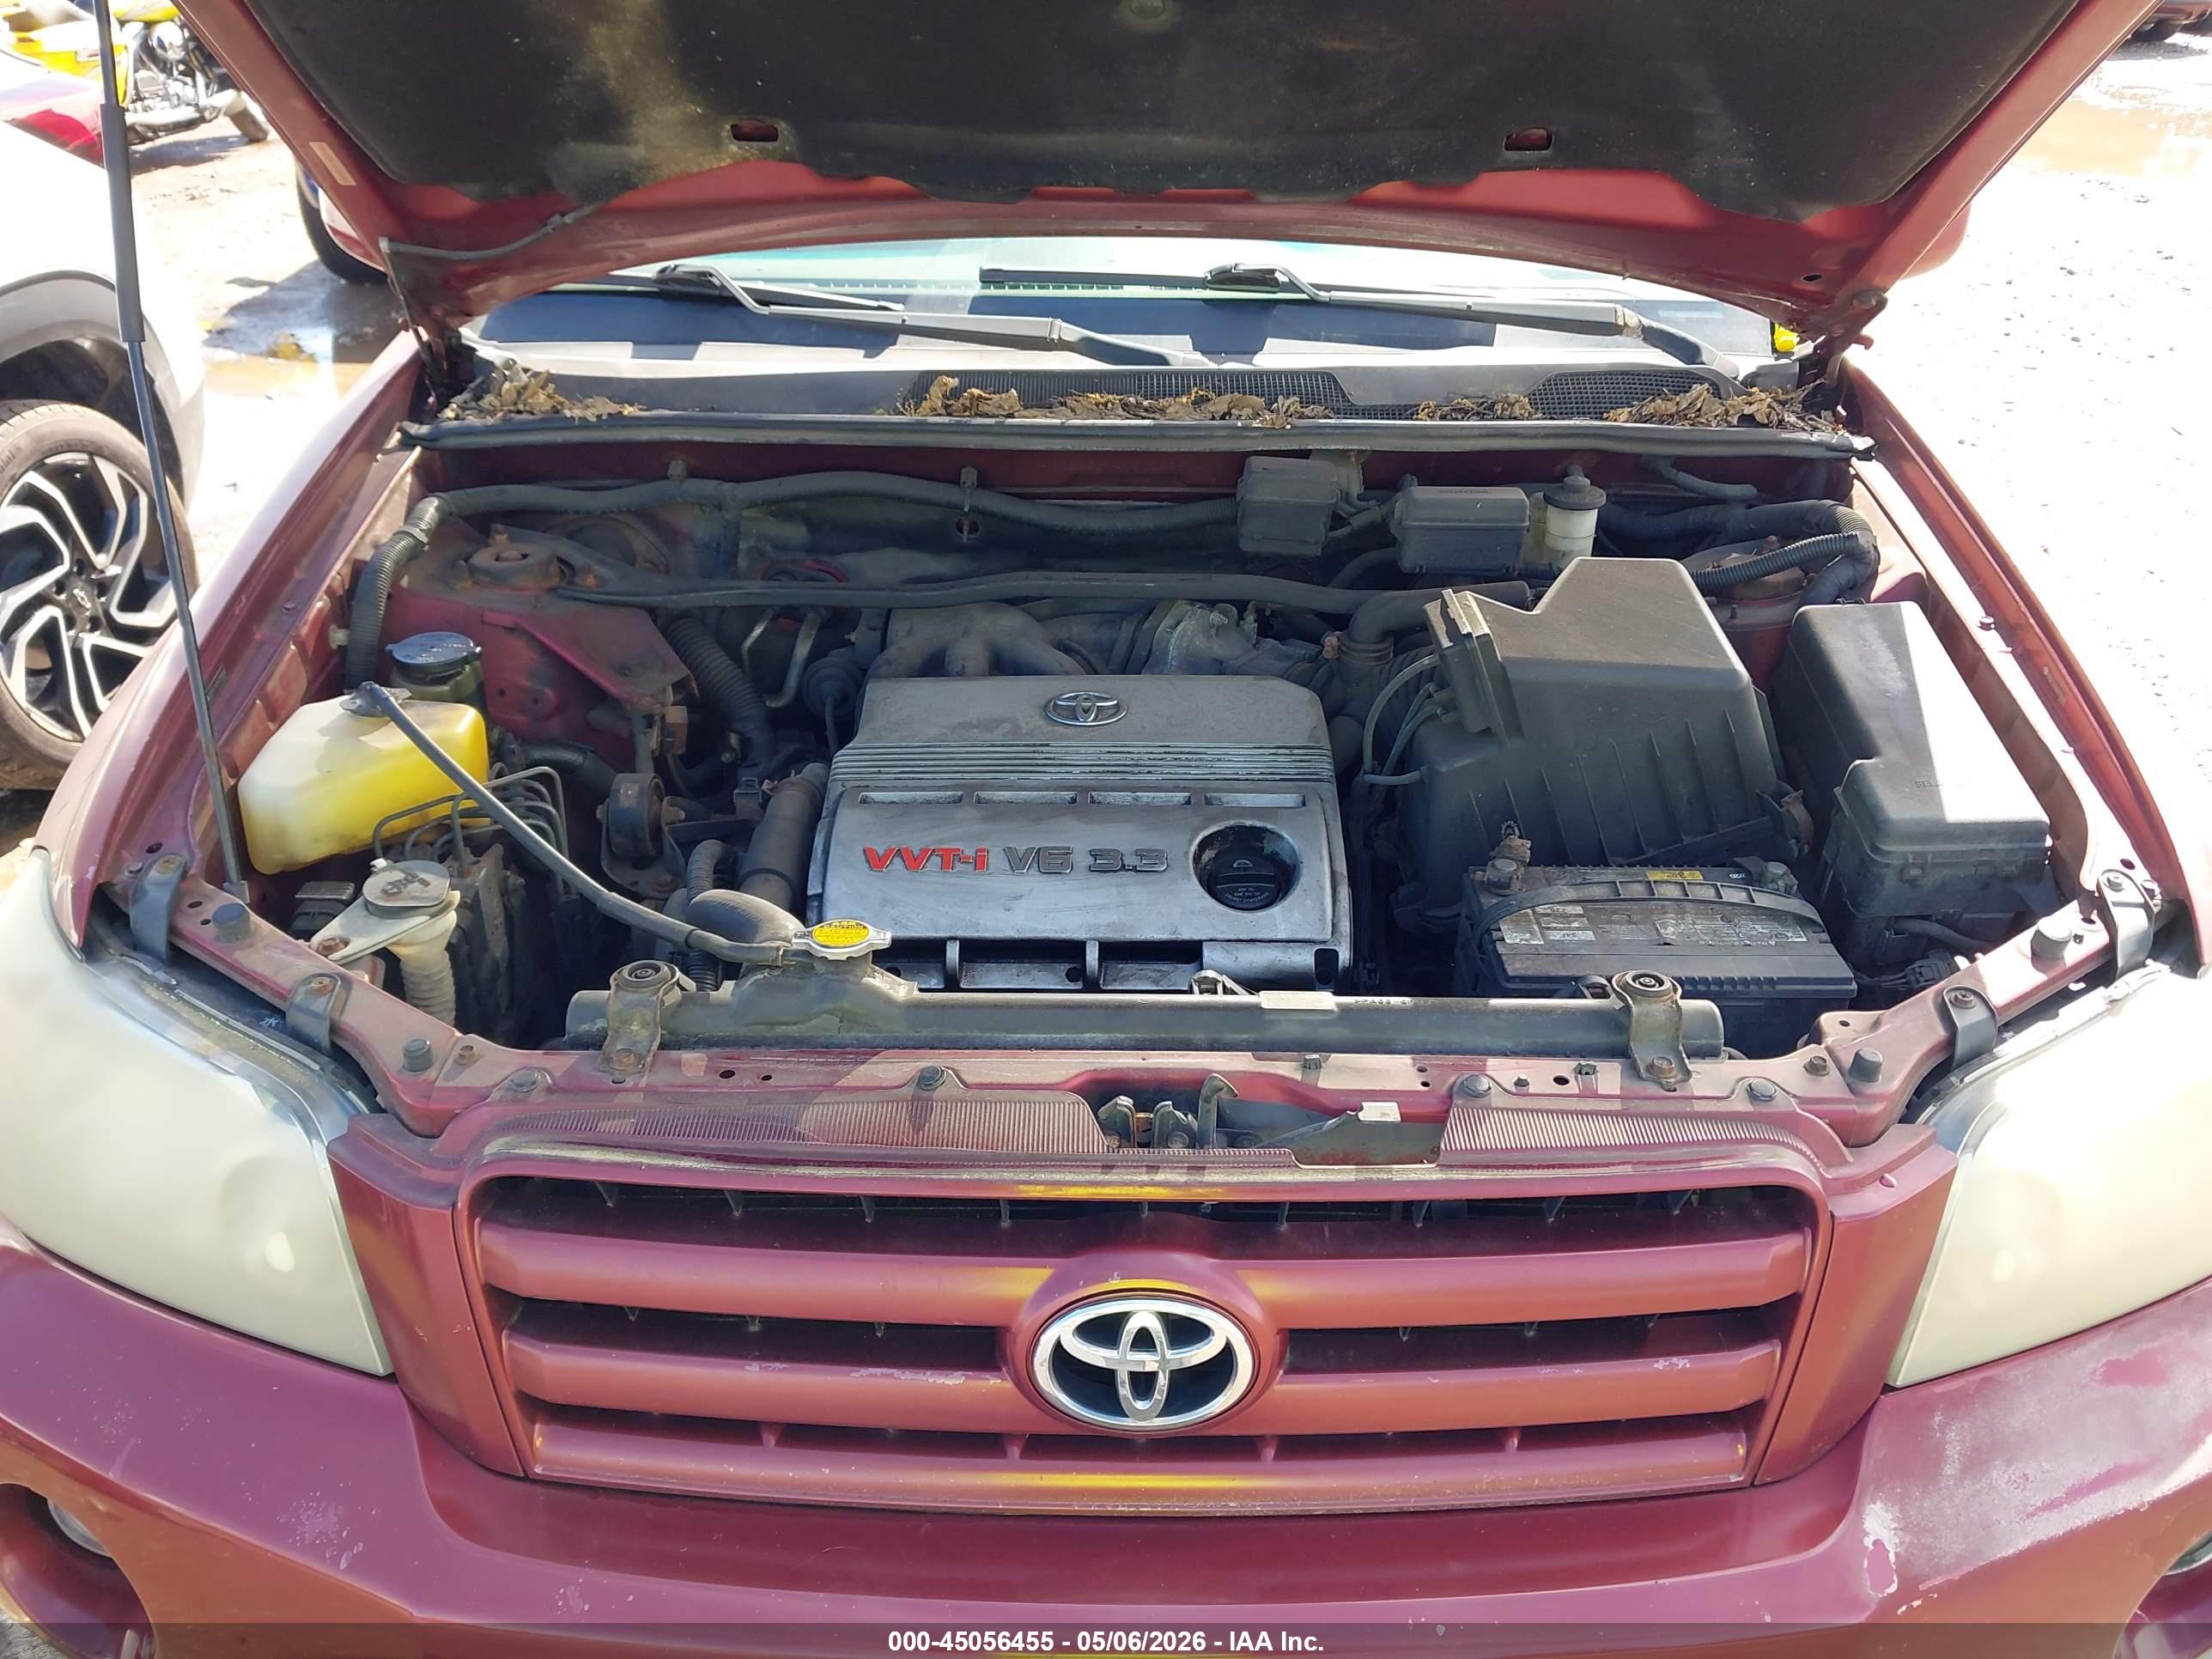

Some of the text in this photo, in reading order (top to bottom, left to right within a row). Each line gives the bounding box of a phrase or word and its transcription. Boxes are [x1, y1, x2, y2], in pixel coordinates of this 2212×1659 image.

[863, 846, 1169, 873] VVT-i V6 3.3
